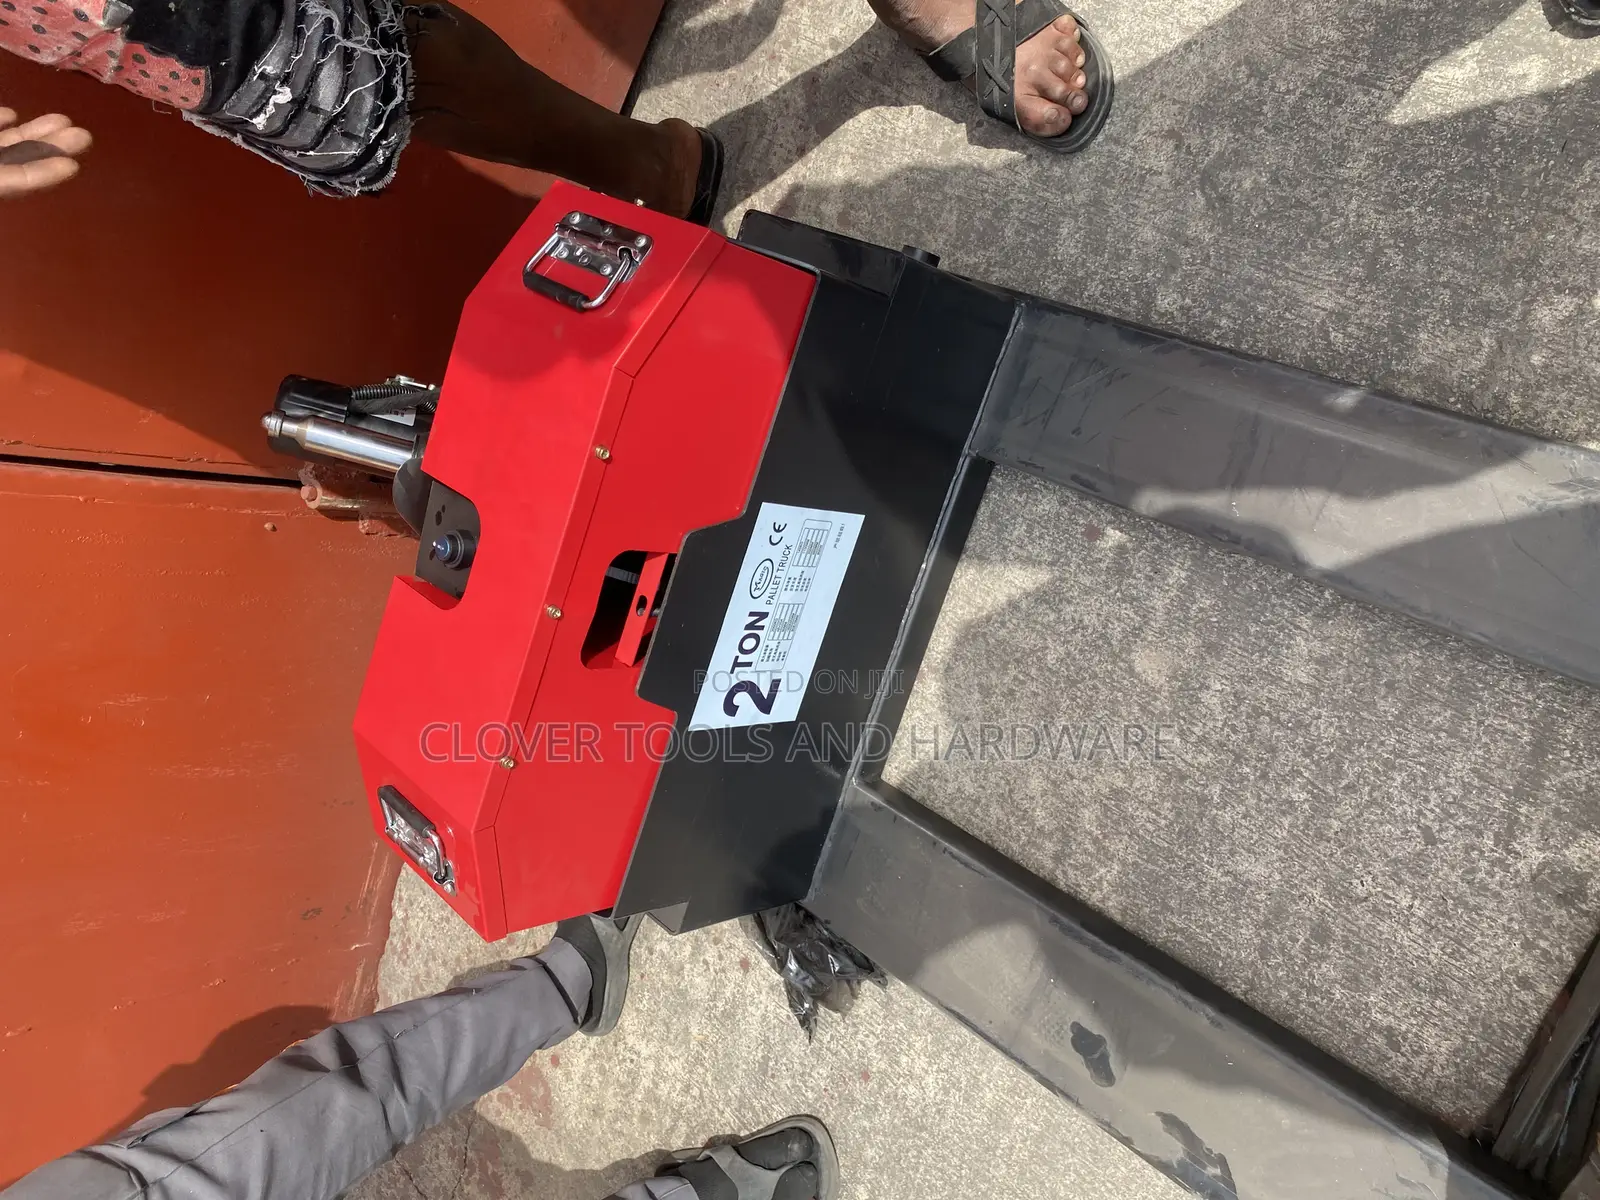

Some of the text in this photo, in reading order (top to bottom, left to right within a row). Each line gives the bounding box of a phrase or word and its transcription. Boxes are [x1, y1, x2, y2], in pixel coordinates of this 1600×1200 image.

[768, 521, 788, 546] CE
[765, 543, 793, 605] PALLET TRUCK
[730, 611, 770, 675] TON
[722, 678, 782, 718] 2
